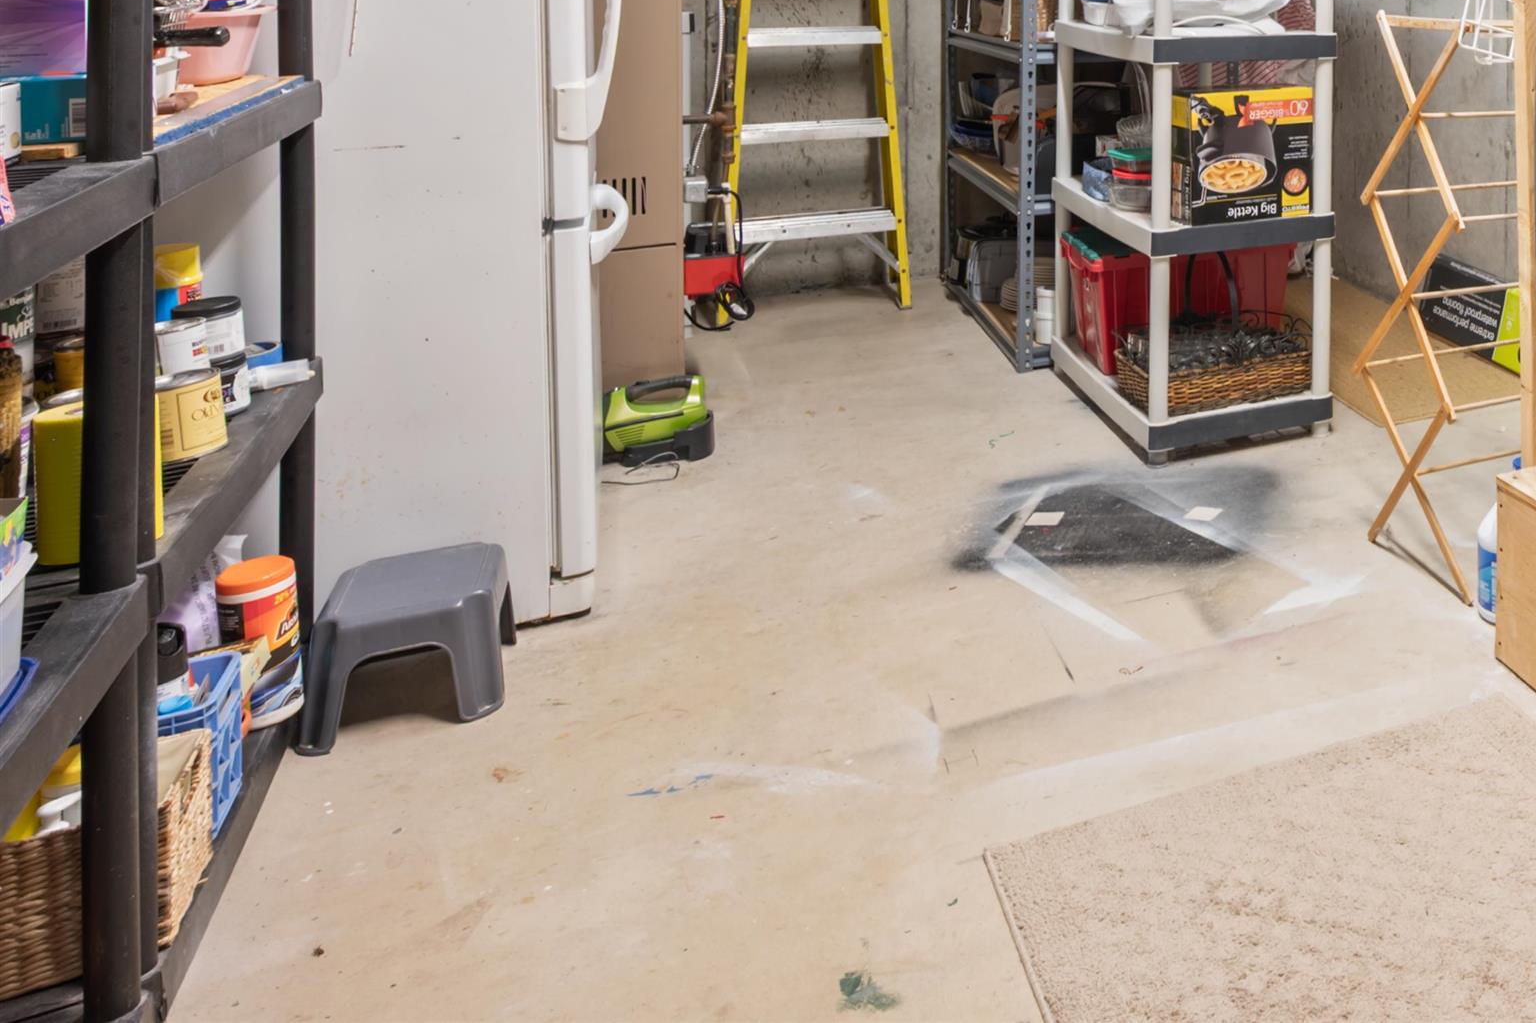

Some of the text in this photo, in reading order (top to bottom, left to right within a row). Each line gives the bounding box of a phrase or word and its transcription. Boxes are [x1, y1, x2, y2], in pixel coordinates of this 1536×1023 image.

[1249, 108, 1284, 120] BIGGER
[1227, 202, 1277, 219] Big Kettle
[1442, 296, 1465, 316] flooring
[1432, 305, 1495, 341] extreme performance
[1464, 307, 1498, 328] waterproof
